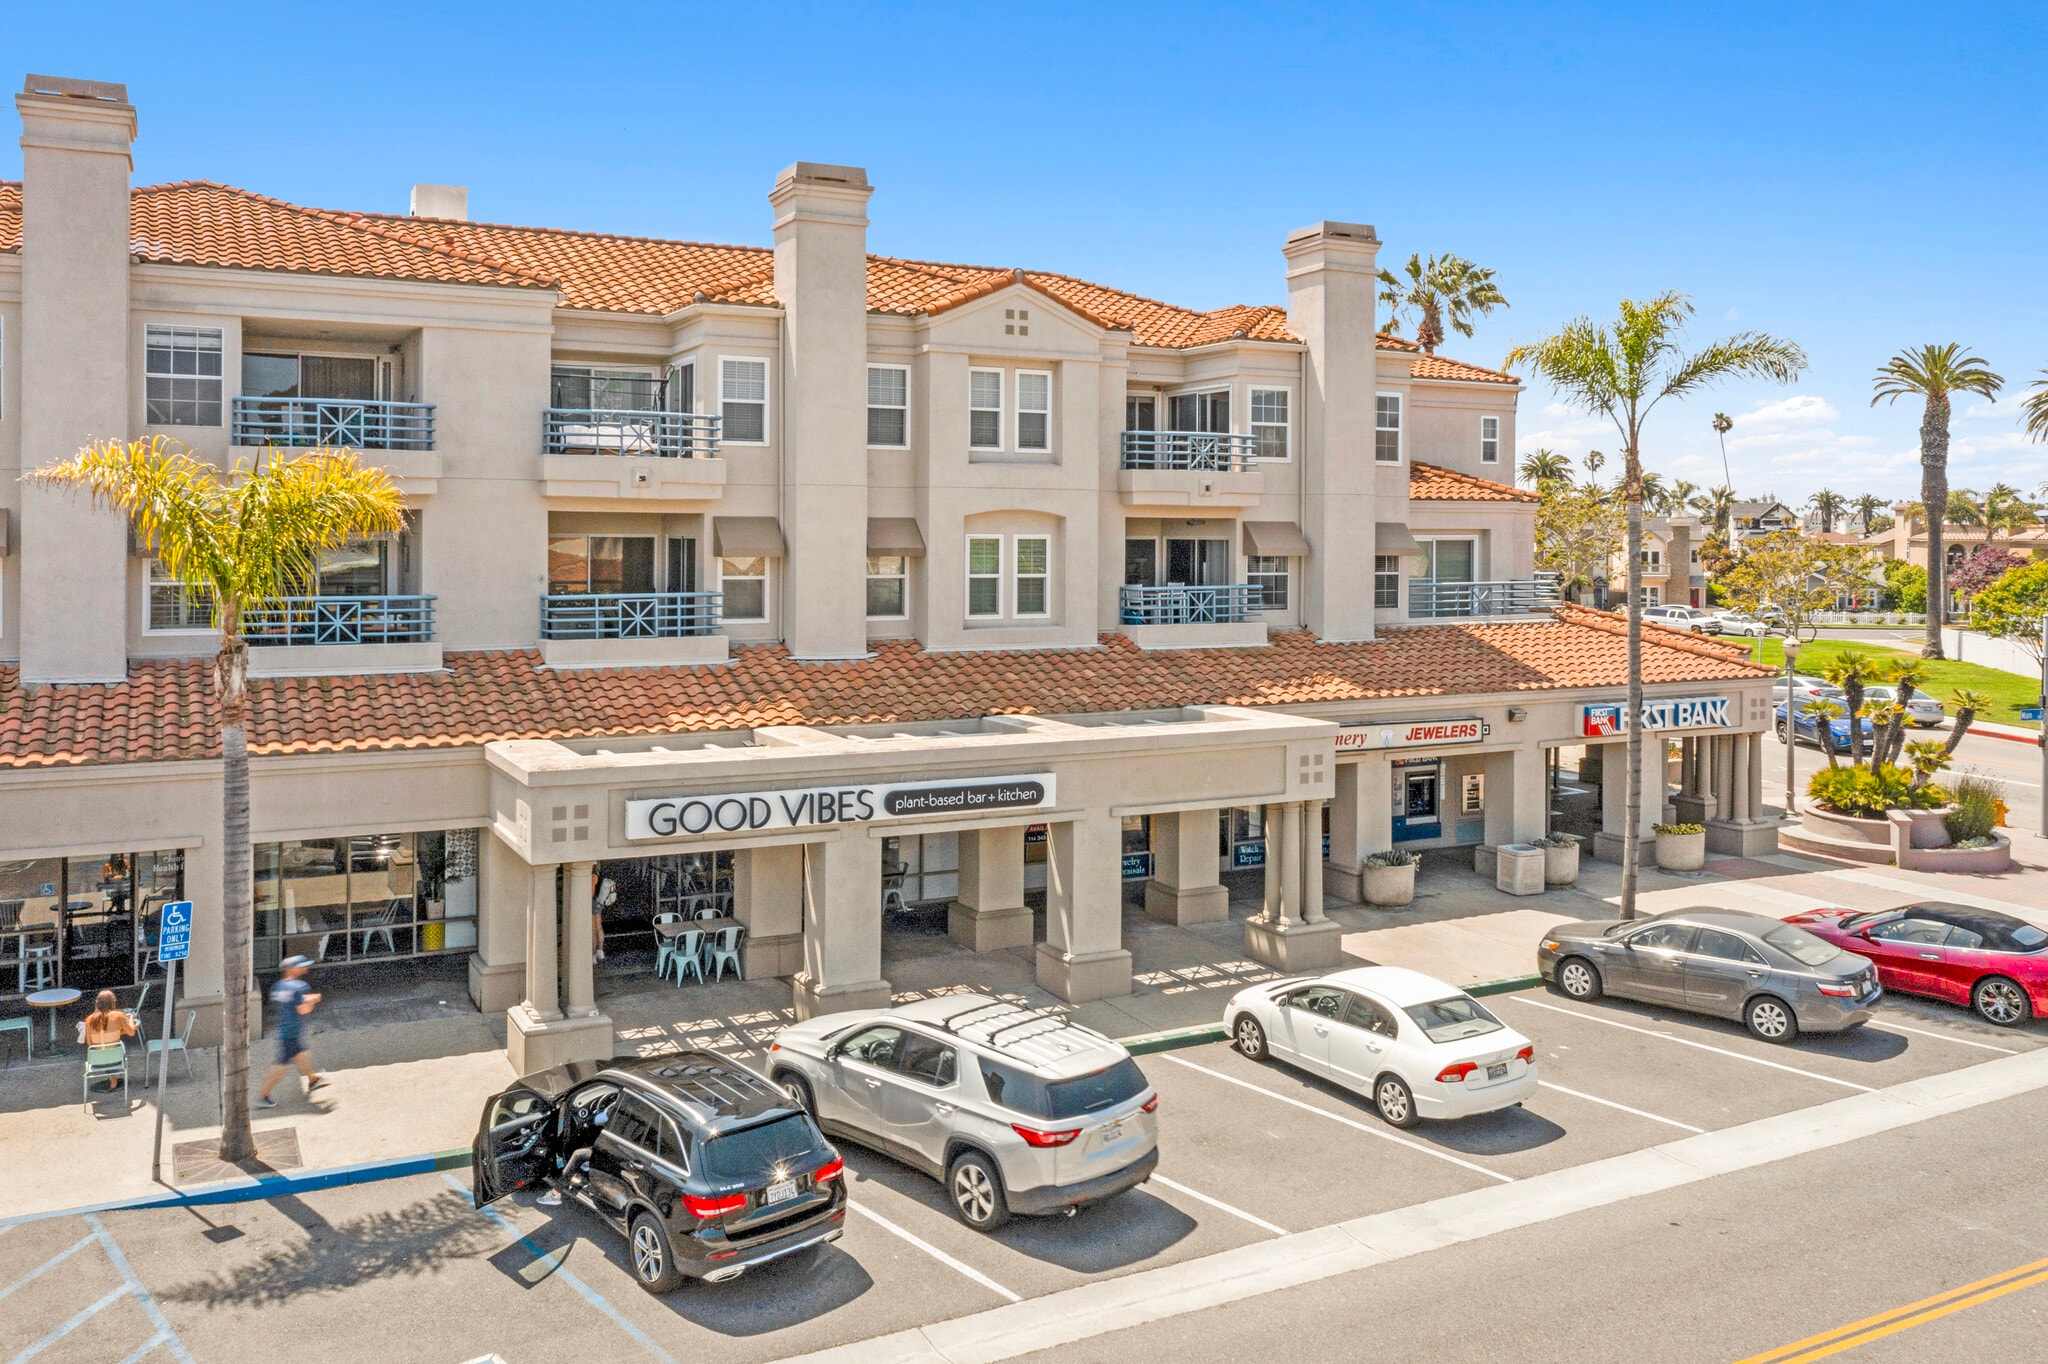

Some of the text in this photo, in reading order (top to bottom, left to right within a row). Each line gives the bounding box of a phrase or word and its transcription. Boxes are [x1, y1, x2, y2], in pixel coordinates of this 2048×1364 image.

[1620, 699, 1732, 731] FRST BANK
[1405, 723, 1478, 741] JEWELERS
[895, 791, 964, 813] plant-based
[967, 790, 986, 804] bar
[998, 788, 1037, 802] kitchen
[648, 789, 875, 836] GOOD VIBES
[1240, 844, 1259, 853] Watch
[1240, 855, 1262, 864] Repair
[162, 923, 190, 935] PARKING
[166, 933, 185, 943] ONLY
